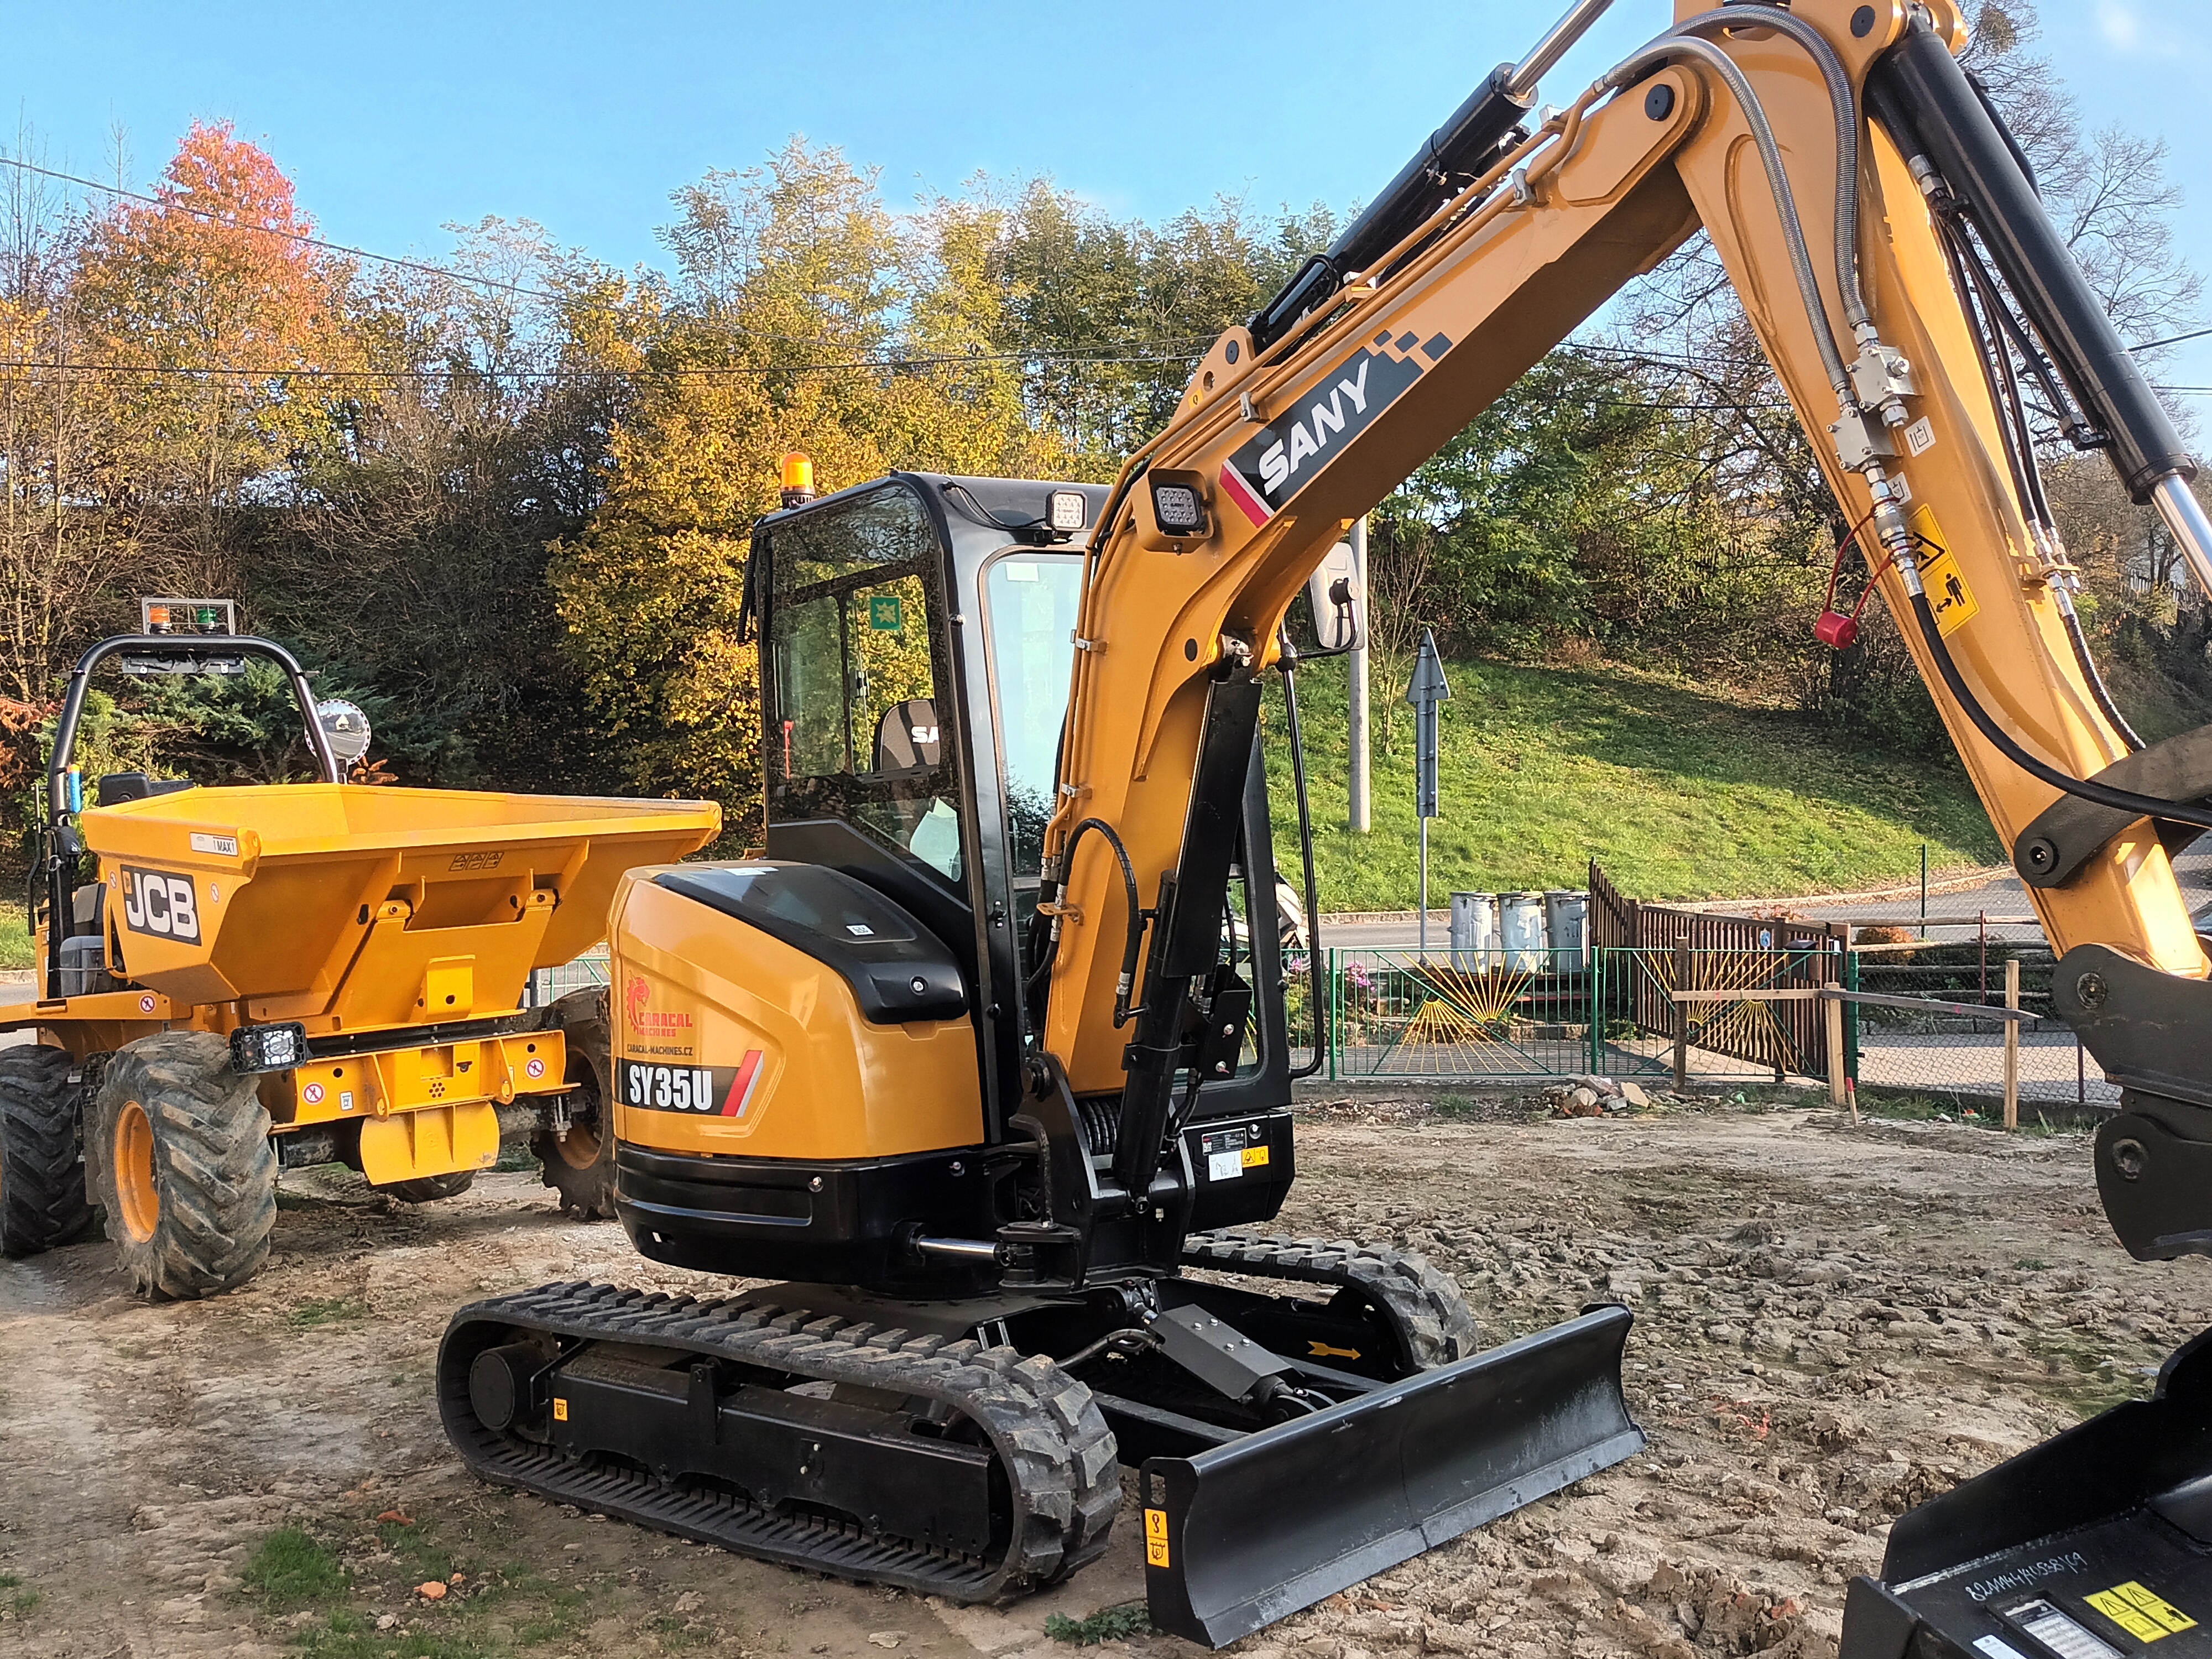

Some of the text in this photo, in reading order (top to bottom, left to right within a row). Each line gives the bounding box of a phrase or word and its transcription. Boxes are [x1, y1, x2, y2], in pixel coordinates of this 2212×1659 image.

[1259, 358, 1369, 496] SANY
[126, 873, 198, 938] JCB
[639, 1012, 693, 1027] CARACAL
[639, 1027, 676, 1037] MACHINES
[627, 1043, 693, 1056] CARACAL-MACHINES.CZ
[629, 1065, 713, 1110] SY35U
